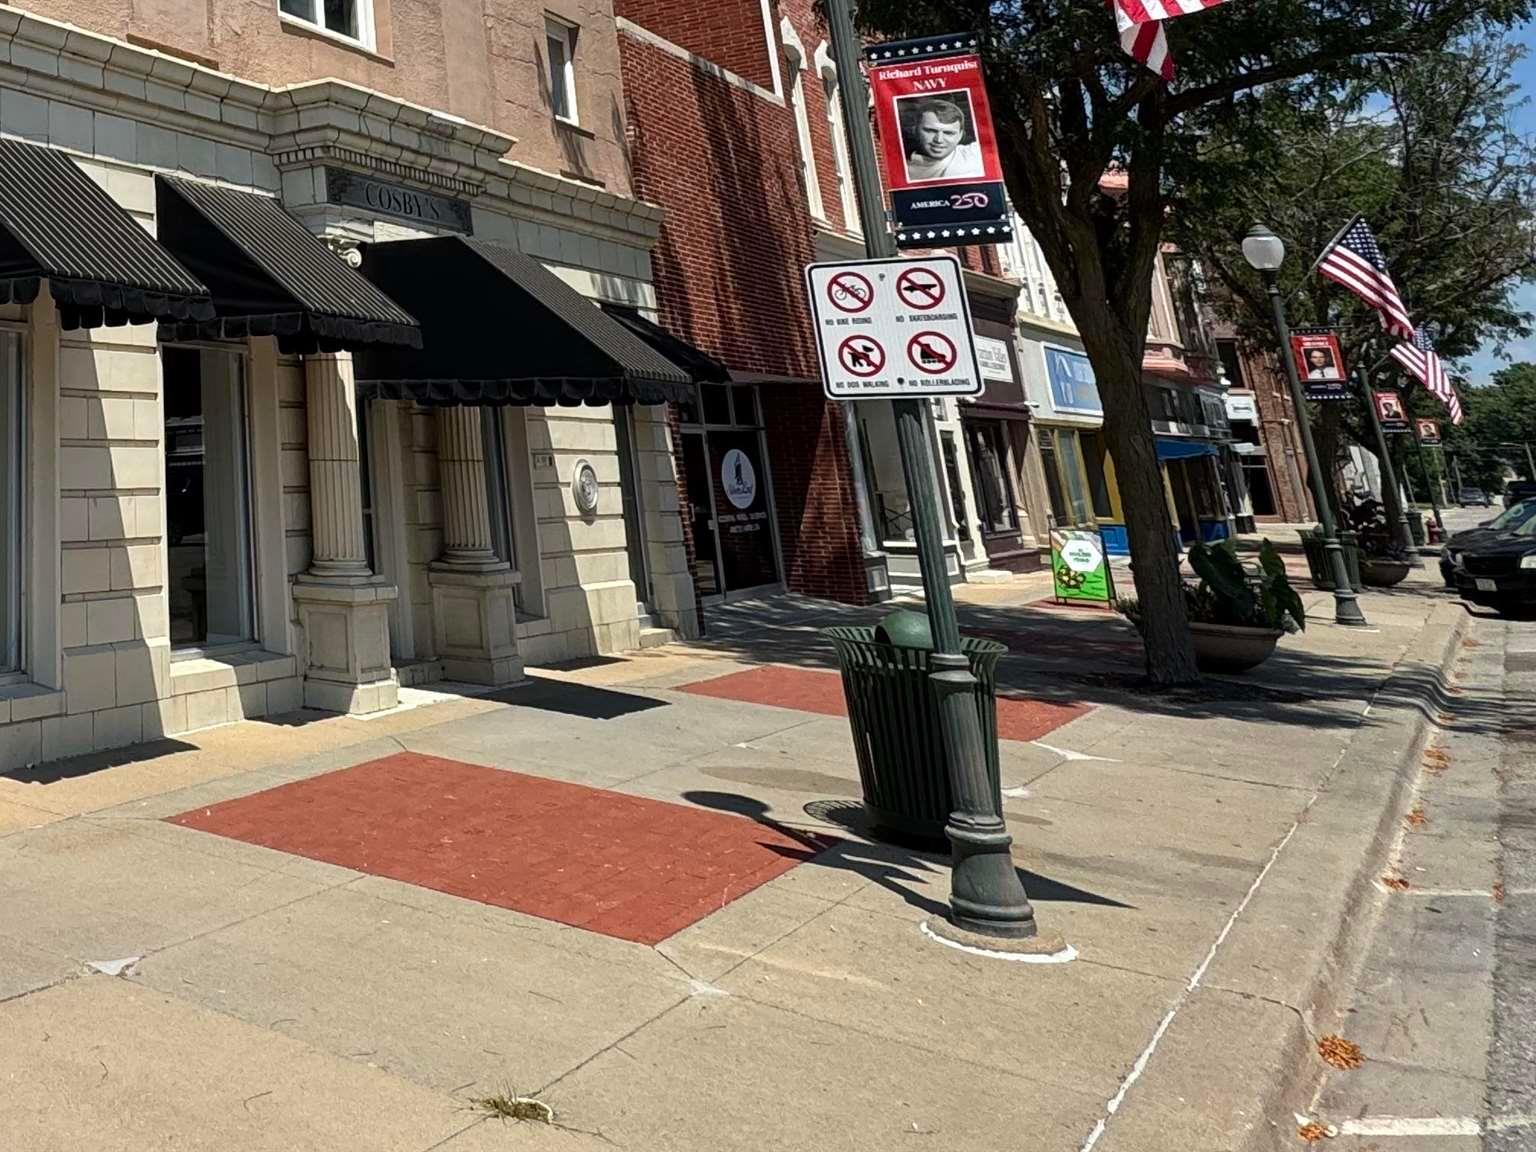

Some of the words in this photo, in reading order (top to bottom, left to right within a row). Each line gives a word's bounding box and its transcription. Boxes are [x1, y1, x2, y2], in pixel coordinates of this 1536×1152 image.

[879, 67, 922, 80] Richard
[912, 78, 947, 91] NAVY
[366, 182, 440, 221] COSBY'S
[910, 199, 950, 210] AMERICA
[950, 192, 989, 209] 250
